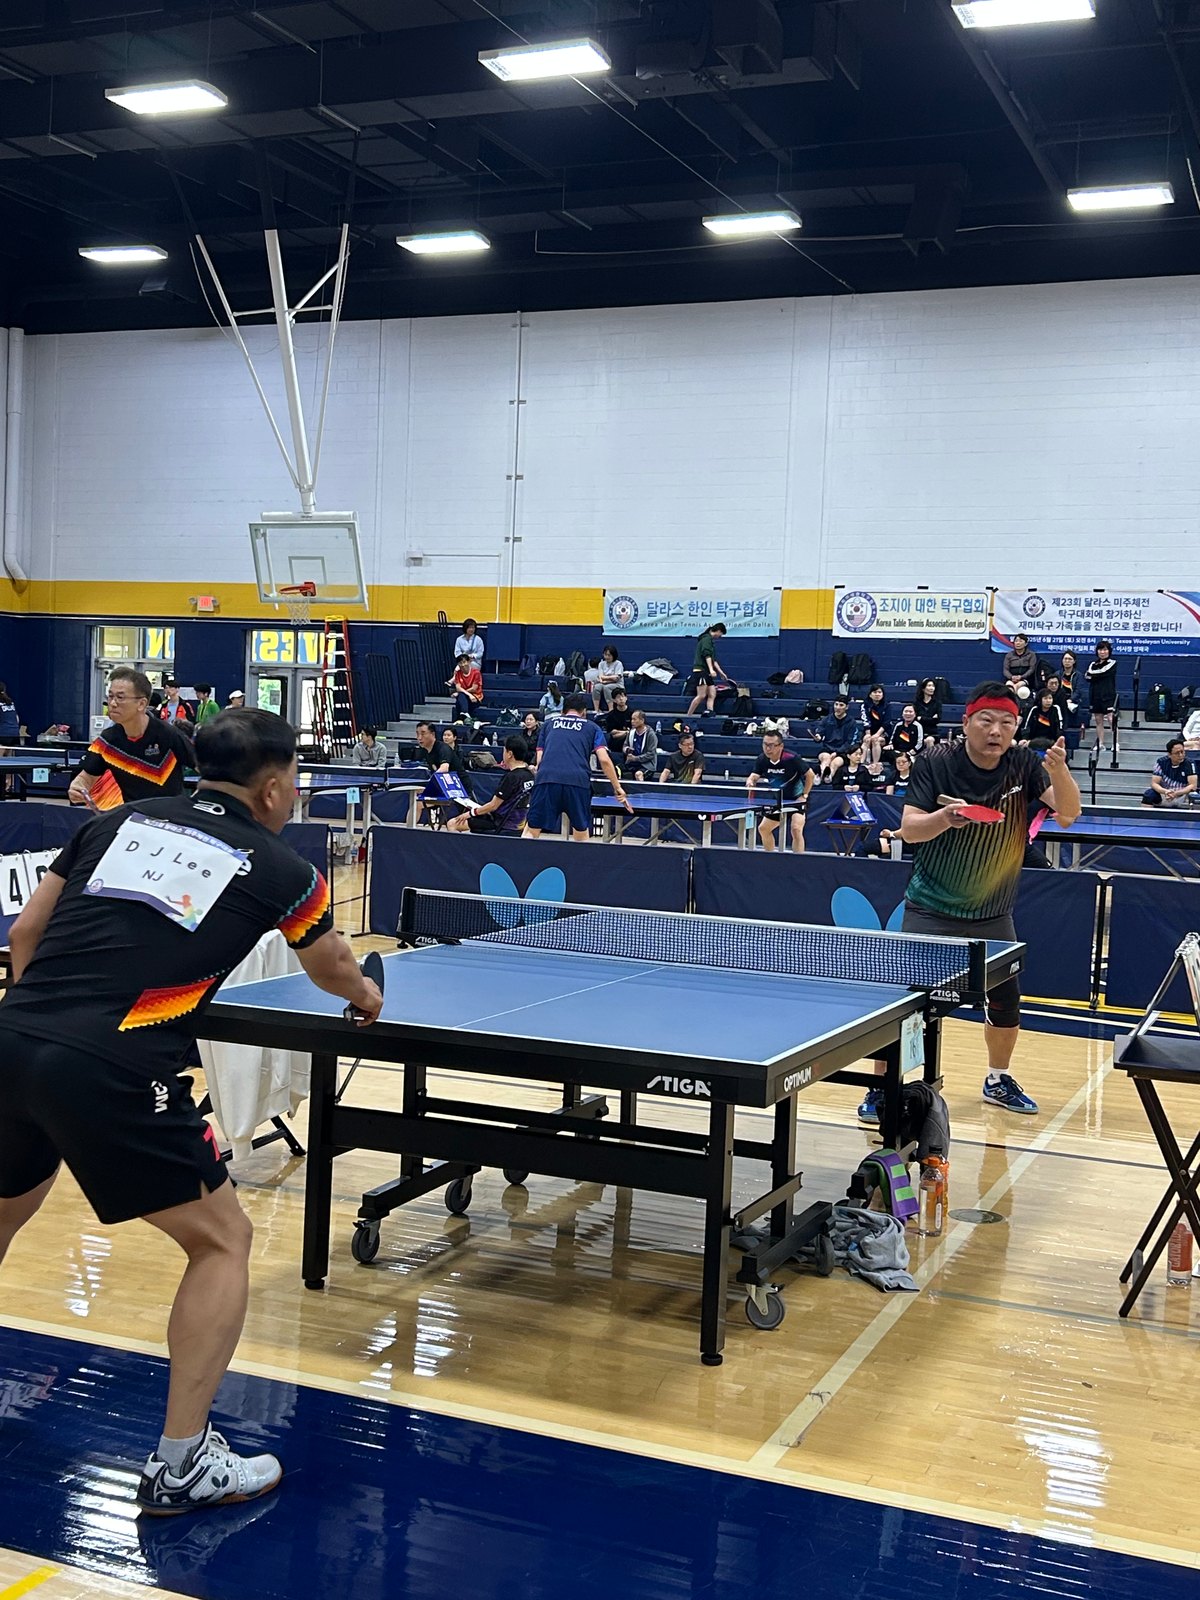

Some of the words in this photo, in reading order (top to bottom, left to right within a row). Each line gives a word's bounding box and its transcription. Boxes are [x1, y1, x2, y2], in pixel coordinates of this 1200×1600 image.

[647, 601, 684, 618] 달라스
[688, 601, 713, 618] 한인
[716, 601, 769, 618] 탁구협회
[879, 598, 911, 613] 조지아
[915, 598, 937, 613] 대한
[941, 598, 984, 614] 탁구협회
[1051, 598, 1081, 608] 제23회
[1084, 598, 1112, 608] 달라스
[1113, 598, 1150, 609] 미주체전
[1058, 609, 1103, 619] 탁구대회에
[1105, 609, 1142, 620] 참가하신
[876, 618, 892, 627] Korea
[892, 619, 907, 627] Table
[908, 619, 924, 628] Tennis
[925, 619, 956, 628] Association
[957, 620, 963, 628] in
[964, 620, 985, 630] Georgia
[1018, 621, 1054, 631] 재미탁구
[1055, 621, 1092, 631] 가족들을
[1094, 621, 1130, 631] 진심으로
[1132, 621, 1182, 633] 환영합니다!
[553, 720, 583, 731] DALLAS
[125, 840, 140, 852] D
[150, 846, 165, 857] J
[173, 852, 212, 879] Lee
[142, 869, 164, 882] NJ
[9, 868, 23, 906] 4
[415, 936, 438, 945] STIGA
[929, 989, 960, 999] STIGA
[783, 1066, 812, 1093] OPTIMUM
[646, 1075, 711, 1097] STIGA
